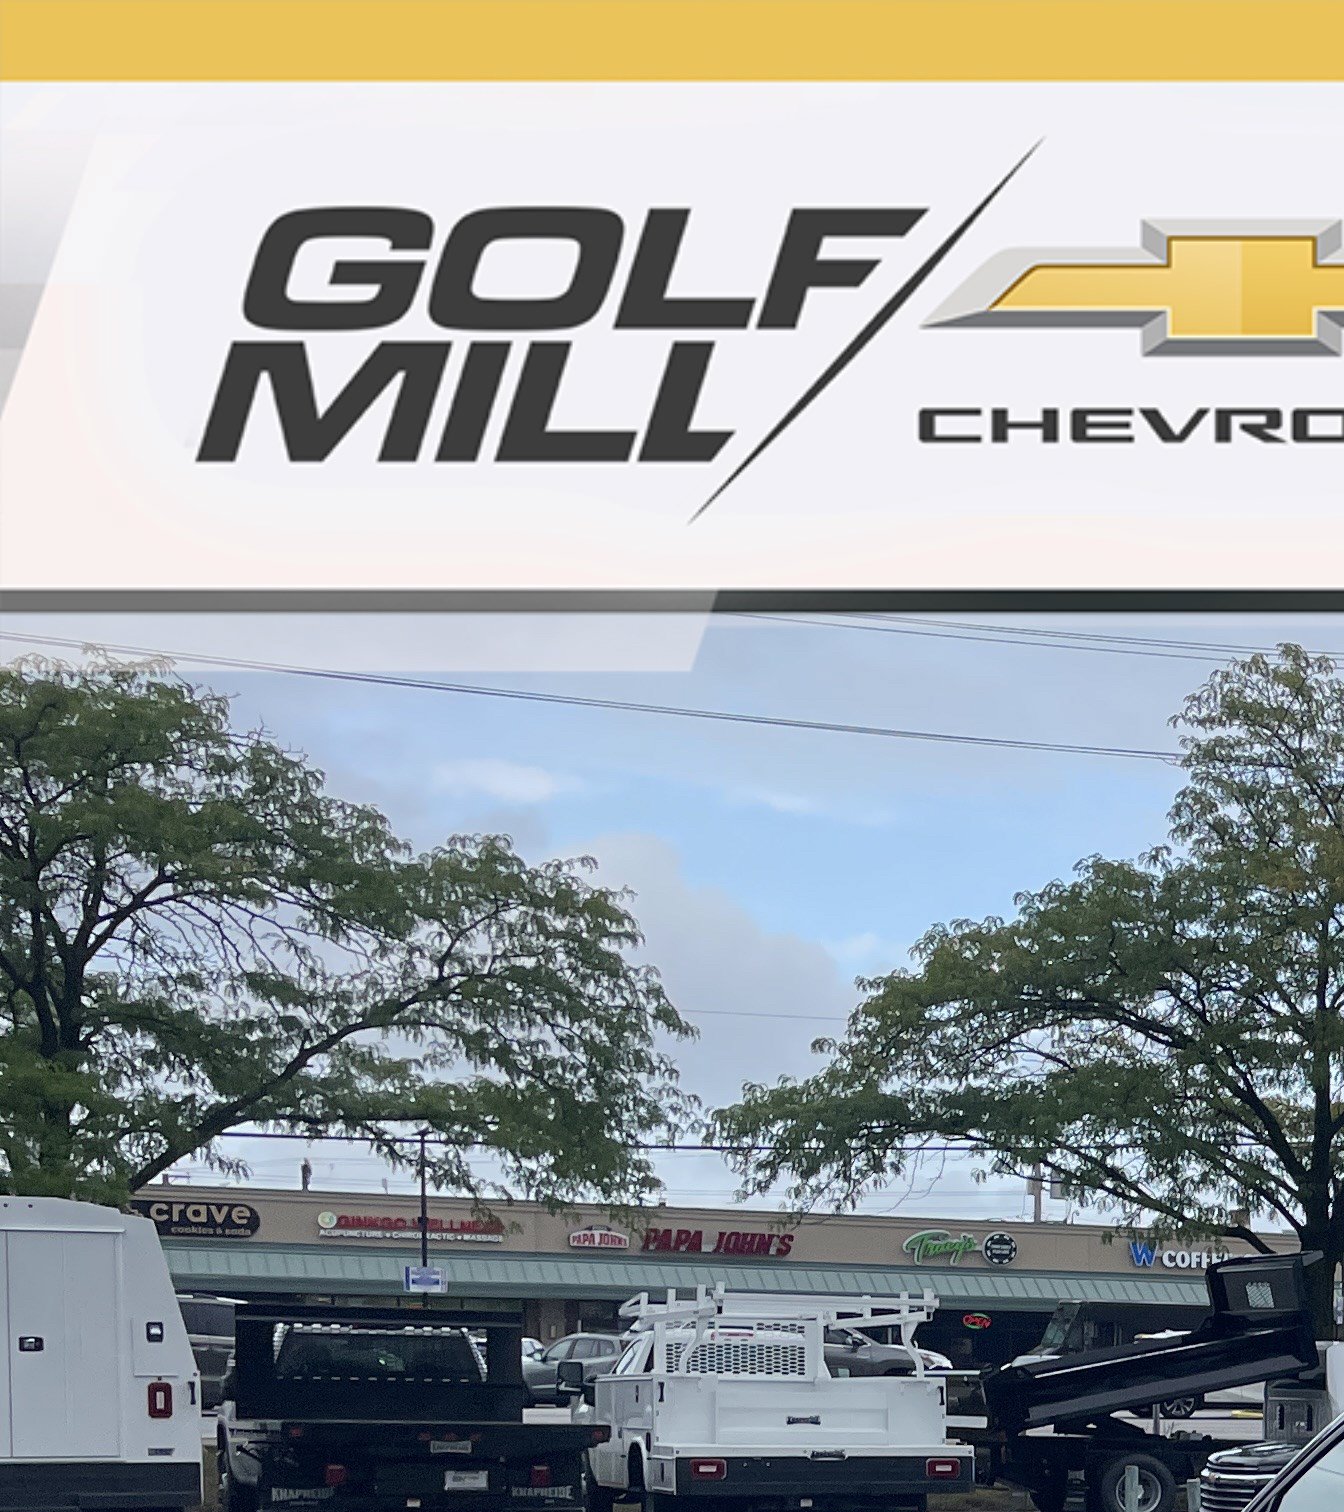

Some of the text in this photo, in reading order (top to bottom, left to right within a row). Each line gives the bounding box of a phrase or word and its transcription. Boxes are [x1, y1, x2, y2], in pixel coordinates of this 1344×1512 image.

[150, 1203, 251, 1225] crave
[641, 1228, 795, 1257] PAPA JOHN'S
